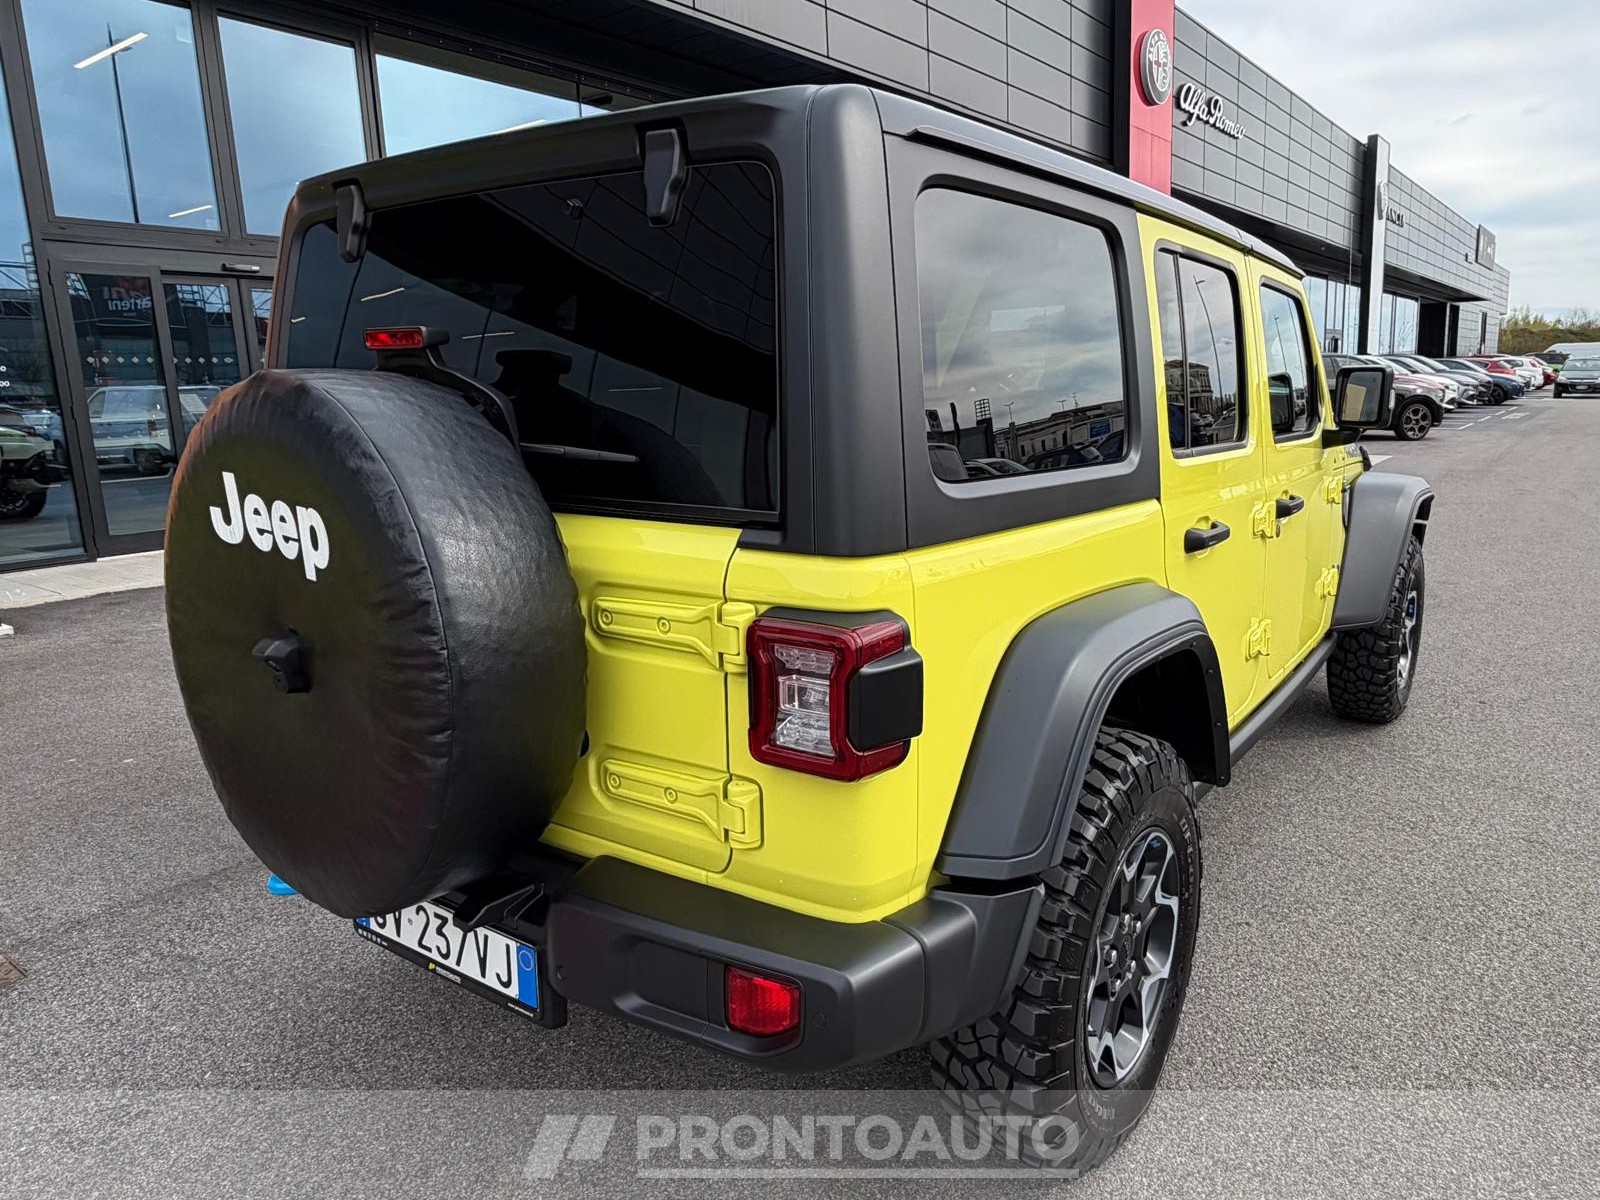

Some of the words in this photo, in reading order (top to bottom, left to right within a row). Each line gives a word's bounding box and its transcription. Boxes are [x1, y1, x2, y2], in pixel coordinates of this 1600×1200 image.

[1180, 83, 1210, 126] Alfa
[1209, 96, 1246, 139] Romeo
[209, 471, 330, 582] Jeep
